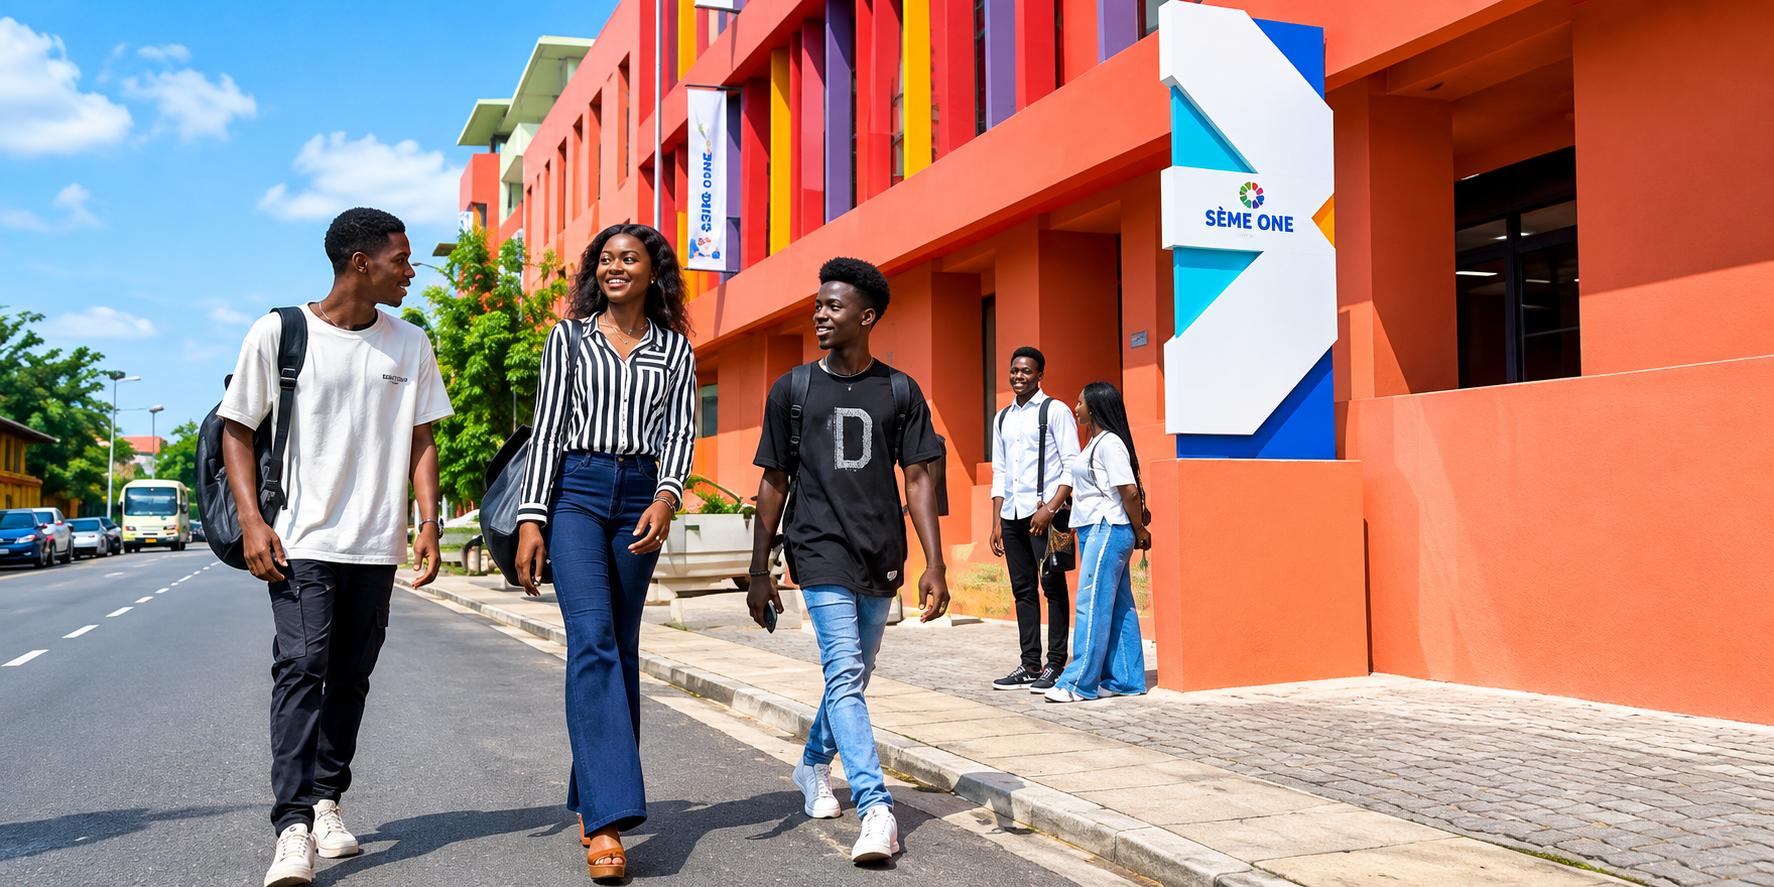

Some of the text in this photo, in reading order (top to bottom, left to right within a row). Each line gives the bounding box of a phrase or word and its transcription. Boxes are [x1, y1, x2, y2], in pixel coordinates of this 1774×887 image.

[1205, 206, 1294, 232] SÈME ONE
[834, 406, 873, 471] D
